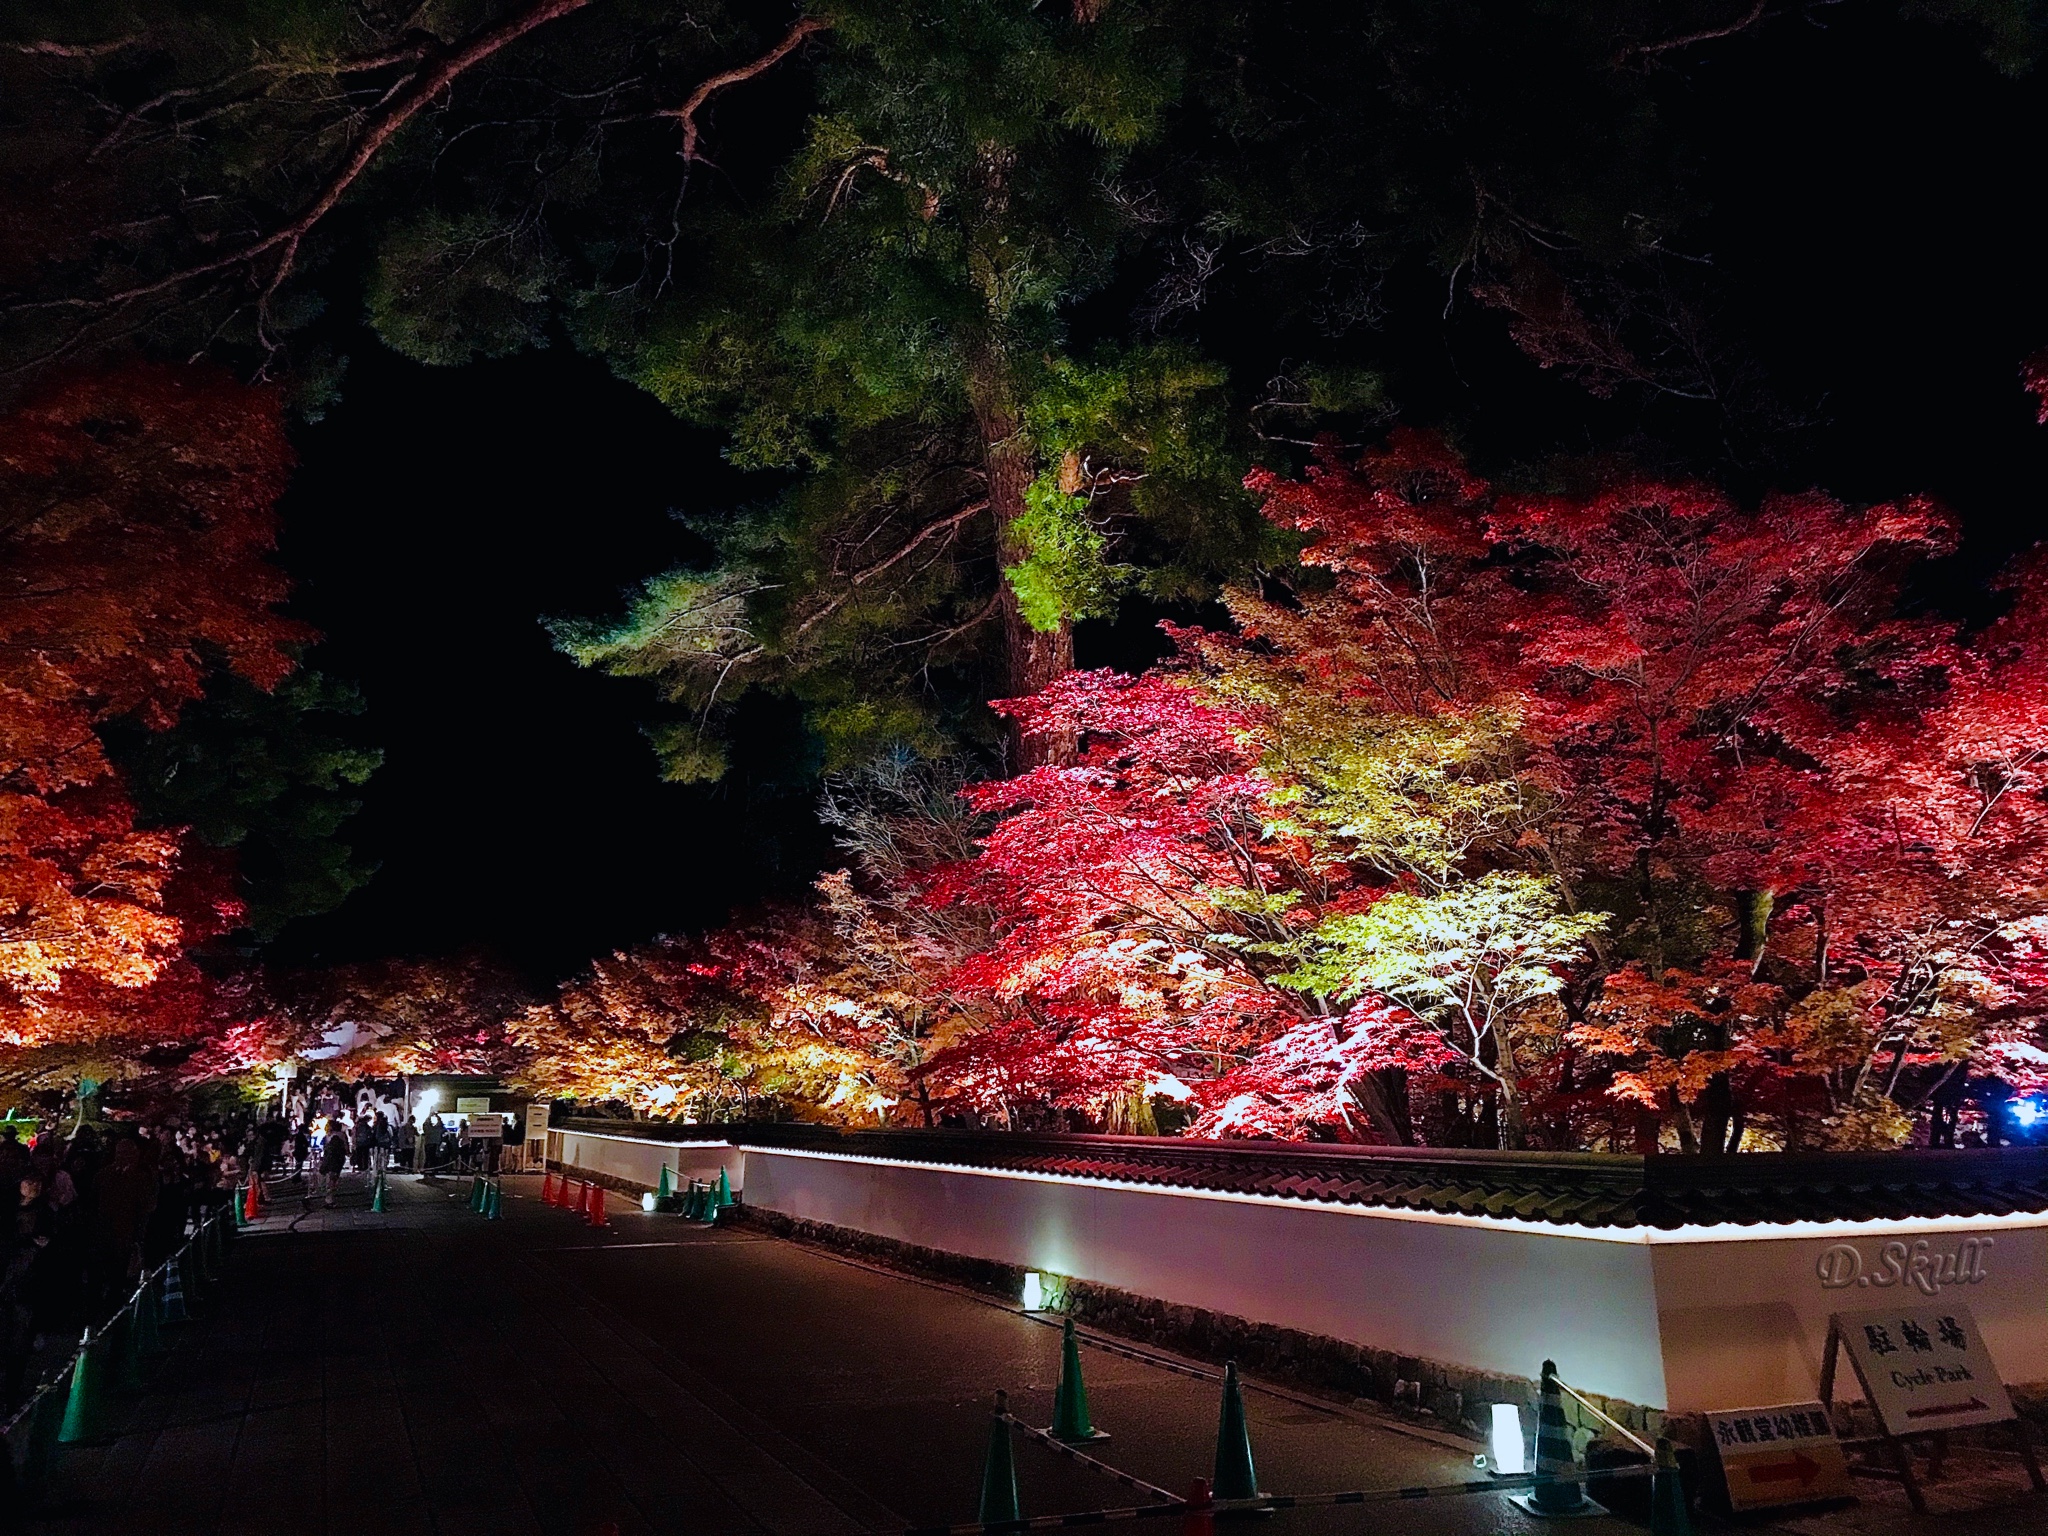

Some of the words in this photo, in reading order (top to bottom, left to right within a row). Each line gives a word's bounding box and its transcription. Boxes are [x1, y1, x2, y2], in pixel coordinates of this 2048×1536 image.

[1864, 1316, 1967, 1356] 駐輪場
[1891, 1369, 1934, 1392] Cycle
[1934, 1364, 1974, 1383] Park
